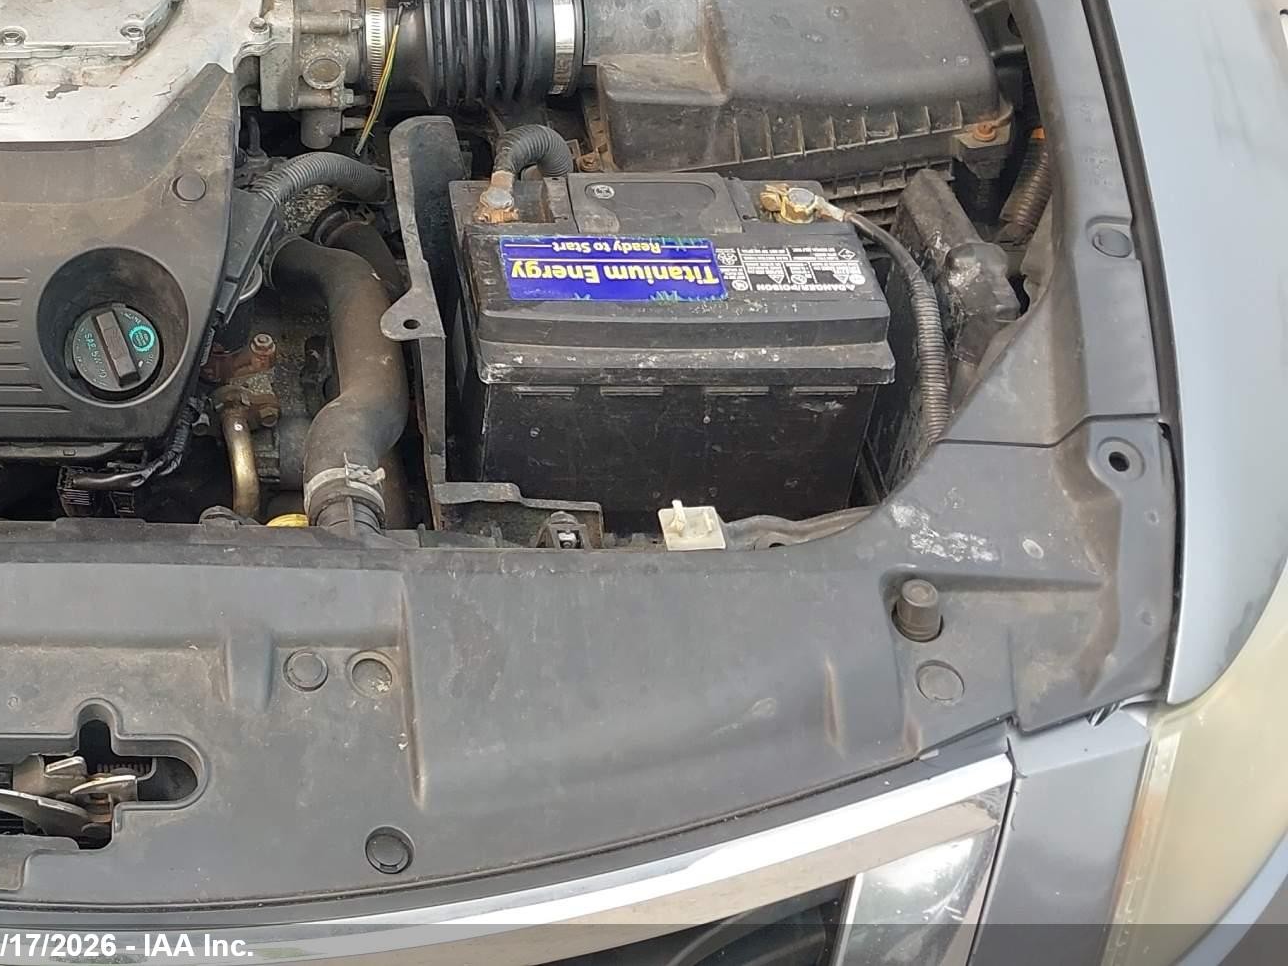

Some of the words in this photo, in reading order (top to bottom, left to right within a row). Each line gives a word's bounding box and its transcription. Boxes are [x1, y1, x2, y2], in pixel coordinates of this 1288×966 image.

[552, 241, 590, 254] Start
[592, 241, 611, 253] to
[613, 241, 661, 254] Ready
[511, 259, 601, 284] Energy
[603, 264, 720, 285] Titanium
